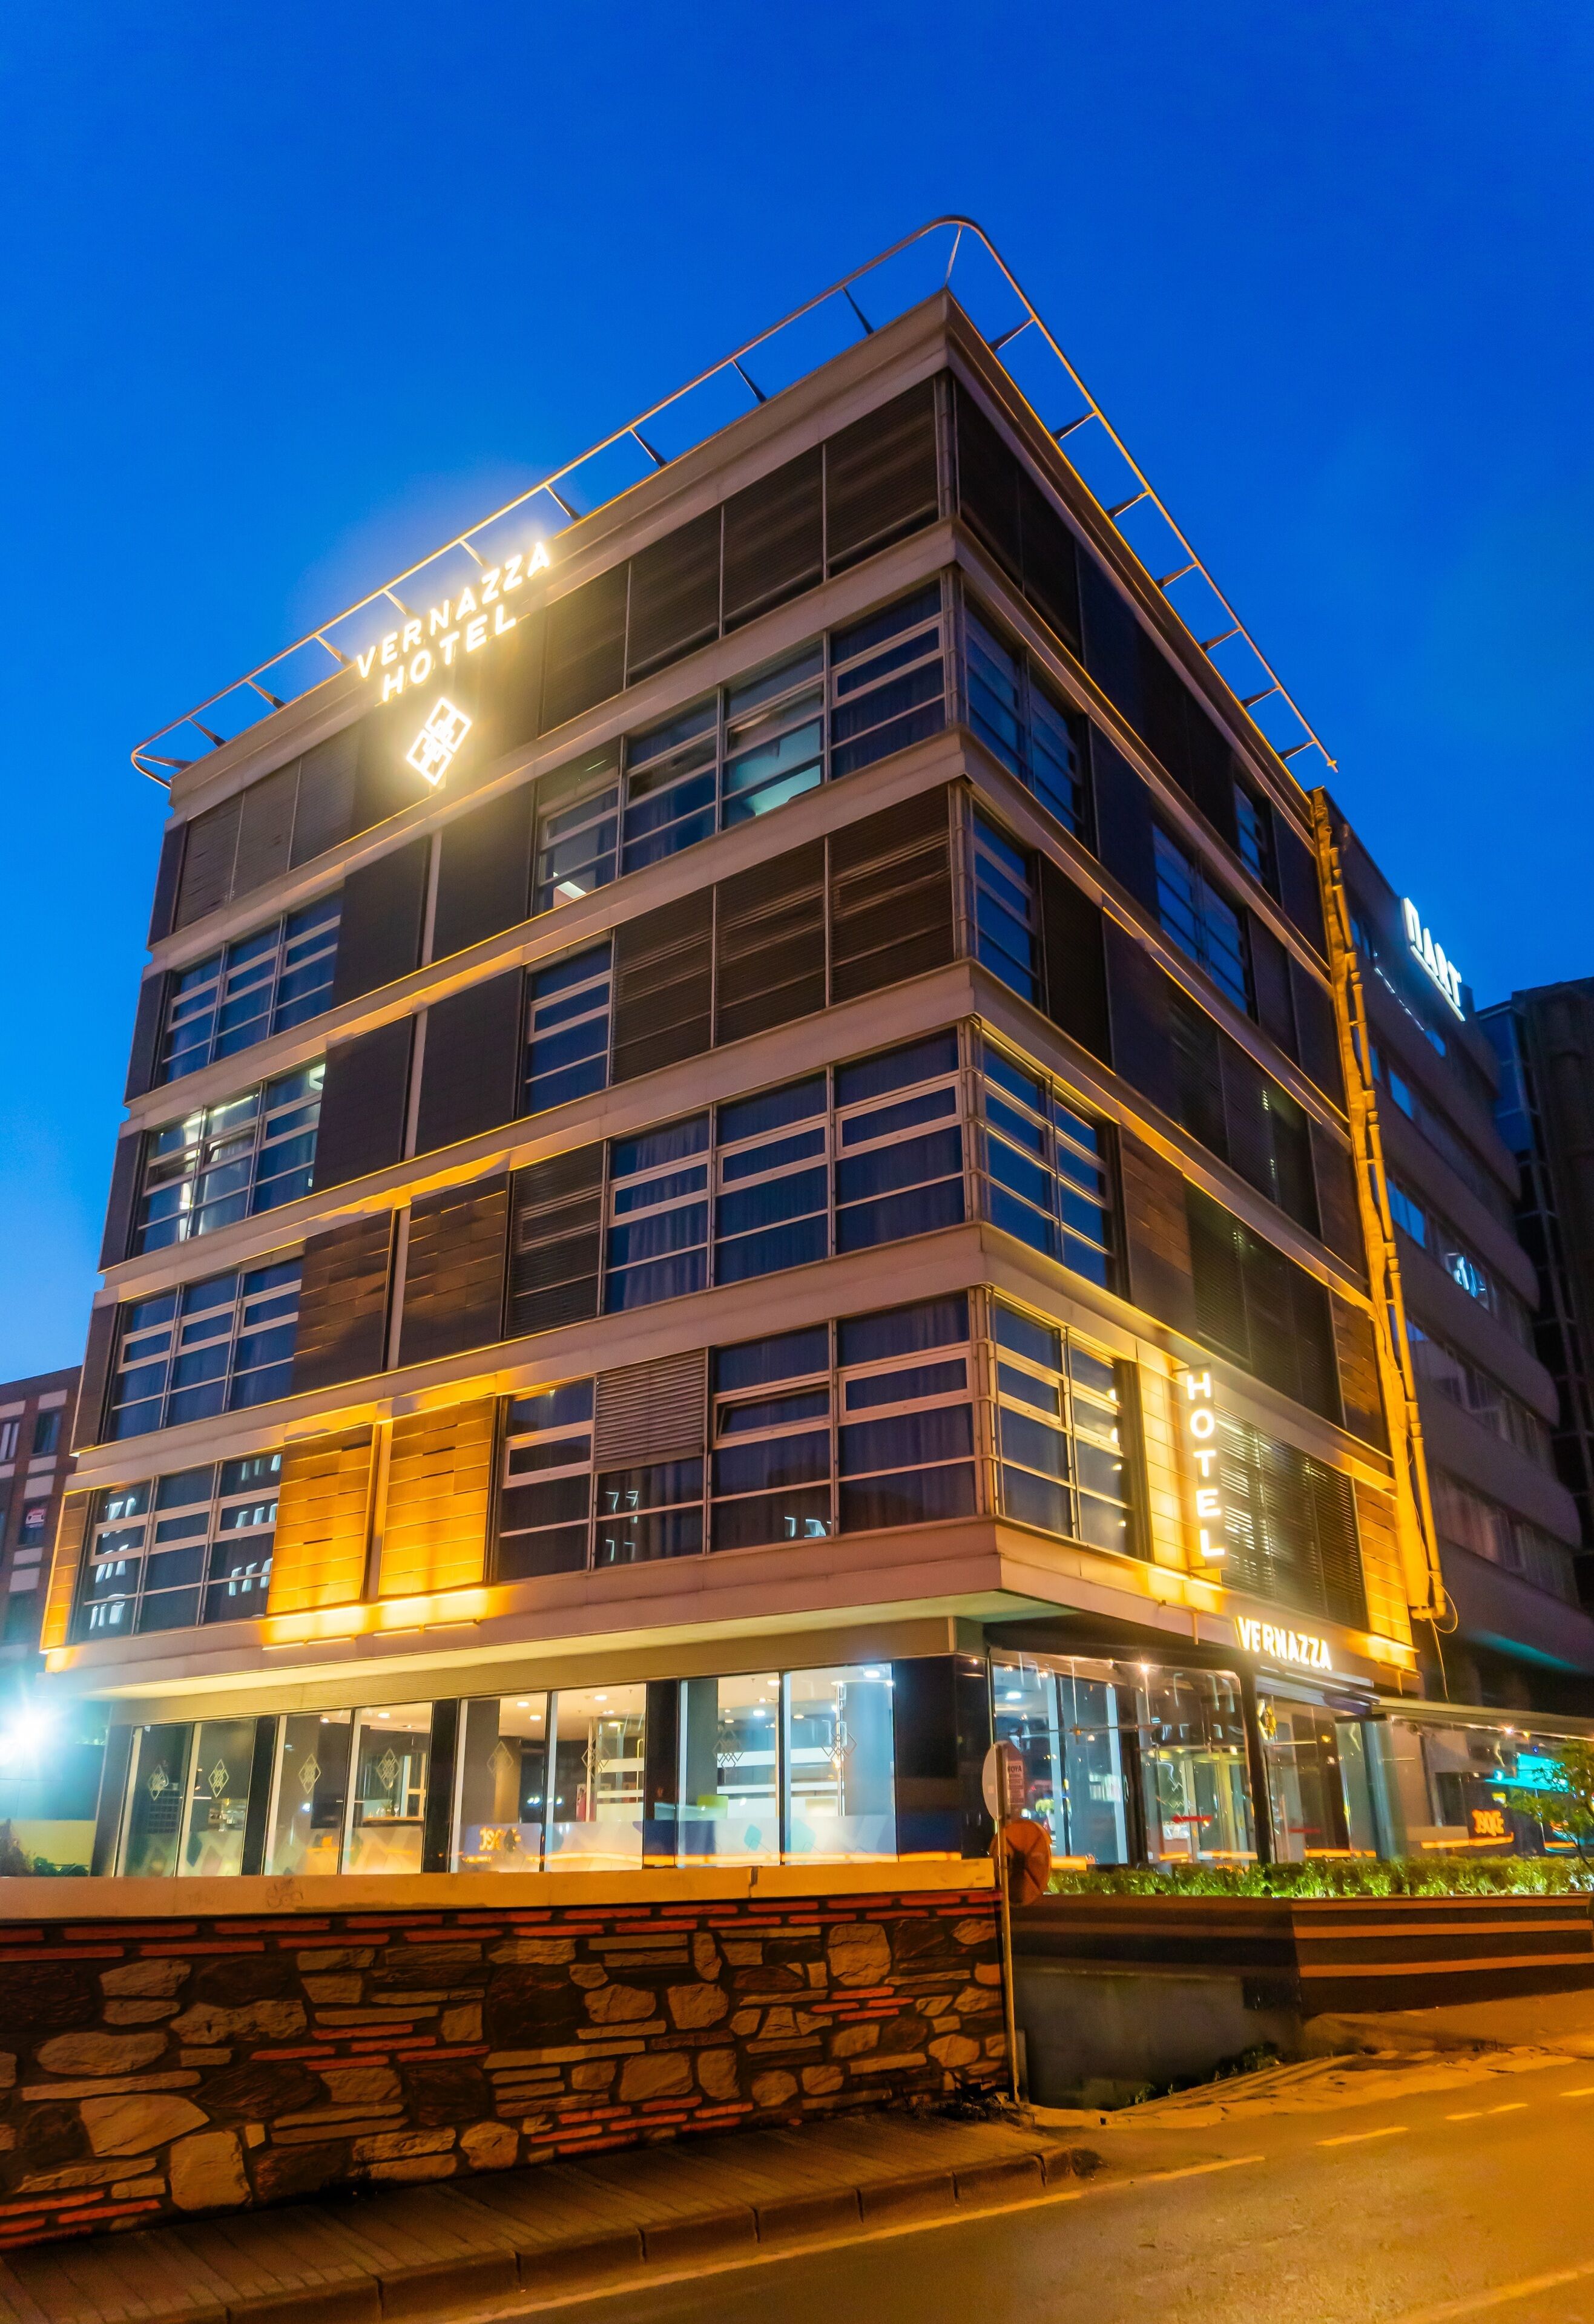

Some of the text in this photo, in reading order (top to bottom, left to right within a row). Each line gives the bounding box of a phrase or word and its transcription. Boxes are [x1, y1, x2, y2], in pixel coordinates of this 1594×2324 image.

[357, 542, 550, 678] VERNAZZA
[382, 604, 516, 702] HOTEL
[1187, 1371, 1225, 1558] HOTEL
[1235, 1616, 1332, 1671] VERNAZZA
